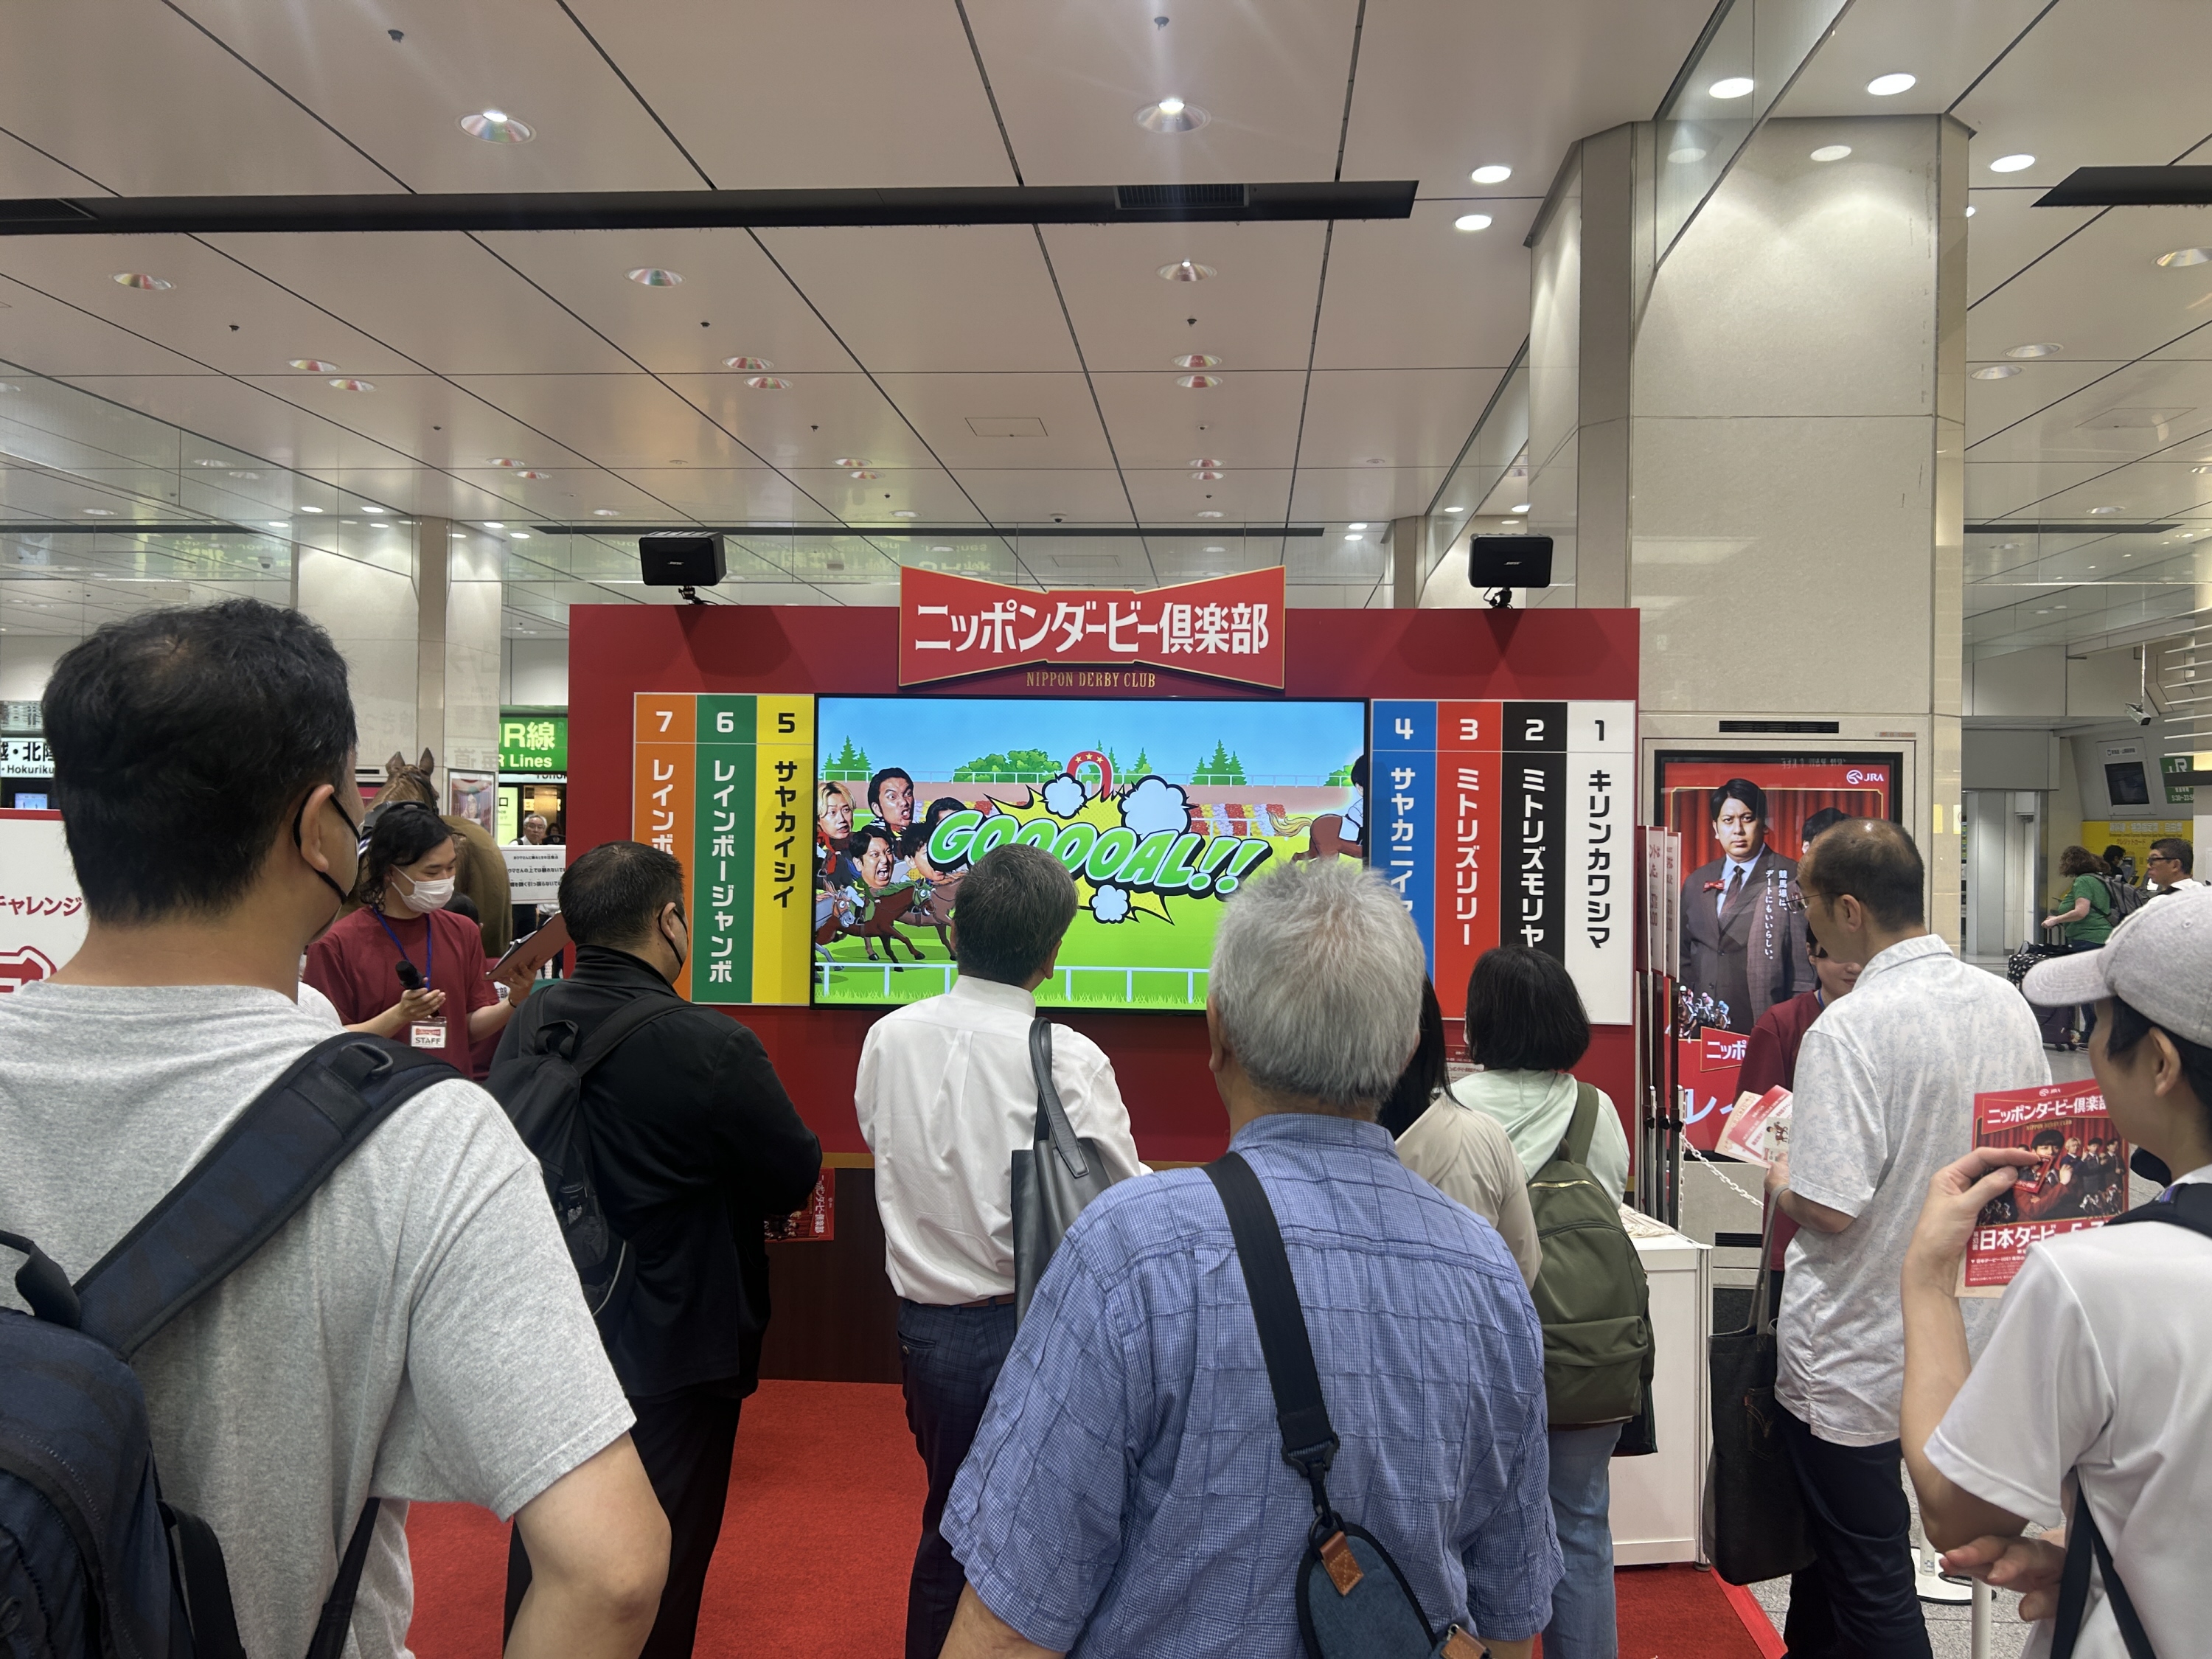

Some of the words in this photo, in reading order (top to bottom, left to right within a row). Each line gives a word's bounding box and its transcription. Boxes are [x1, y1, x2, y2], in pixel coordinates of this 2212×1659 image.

[915, 599, 1269, 655] ニッポンダービー倶楽部
[1026, 672, 1073, 686] NIPPON
[1079, 672, 1119, 687] DERBY
[1124, 672, 1155, 688] CLUB
[655, 712, 673, 732] 7
[717, 712, 734, 733] 6
[778, 712, 795, 734] 5
[1395, 718, 1413, 740] 4
[1459, 719, 1478, 740] 3
[1525, 719, 1545, 740] 2
[1595, 720, 1605, 741] 1
[499, 721, 555, 751] R線
[7, 765, 55, 774] Hokuriku
[509, 754, 552, 768] Lines
[1864, 773, 1884, 782] JRA
[773, 761, 798, 908] サヤカイシイ
[1455, 768, 1480, 945] ミトリズリリー
[1520, 768, 1545, 947] ミトリズモリヤ
[1587, 770, 1612, 949] キリンカワシマ
[709, 760, 735, 983] レインボージャンボ
[1764, 869, 1775, 960] デートにもいいらしい。
[415, 1037, 442, 1045] STAFF
